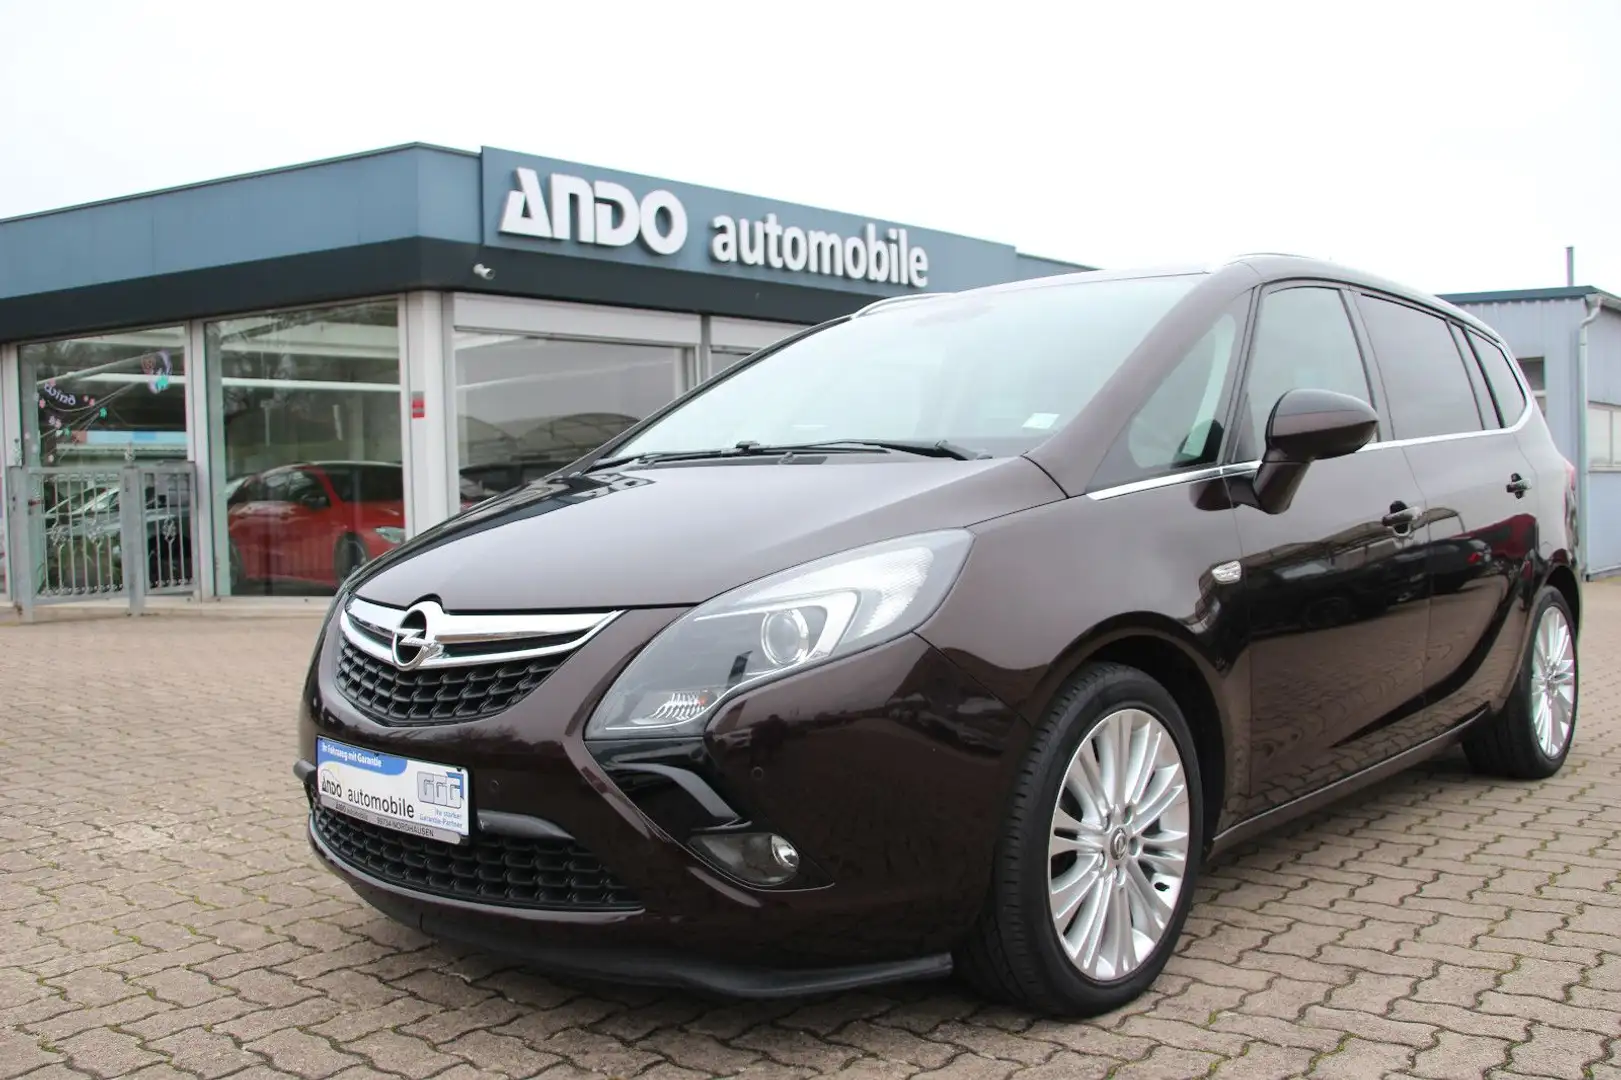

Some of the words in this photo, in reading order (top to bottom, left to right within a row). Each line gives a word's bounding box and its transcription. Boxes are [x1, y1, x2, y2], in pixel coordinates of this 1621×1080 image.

[499, 167, 688, 255] ANDO
[710, 213, 928, 287] automobile
[348, 788, 415, 818] automobile
